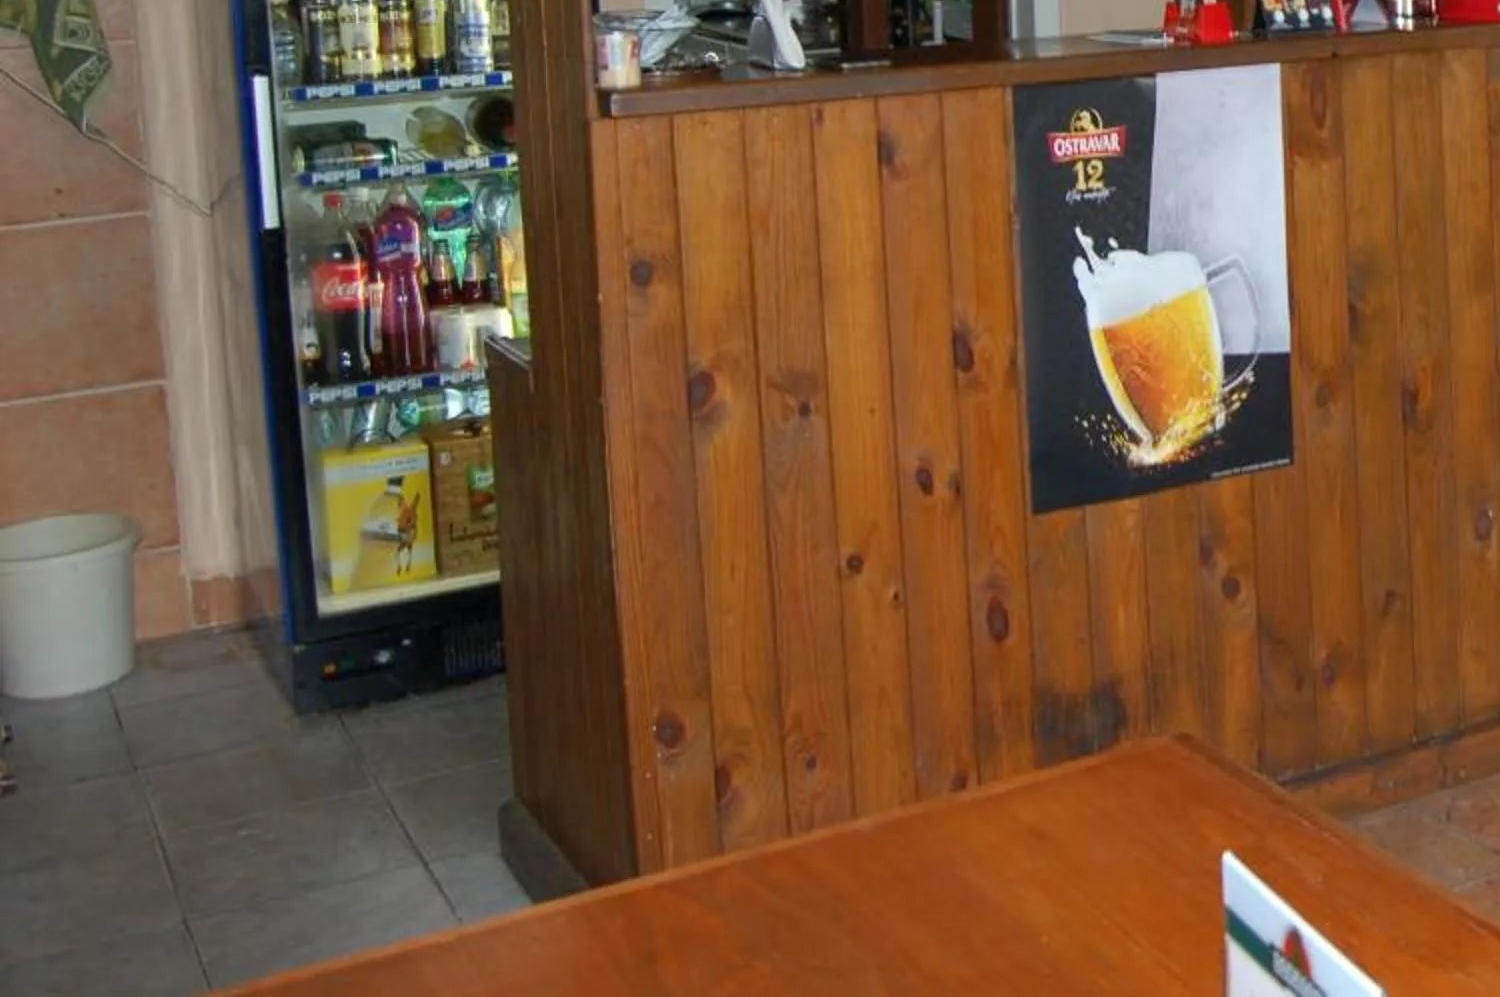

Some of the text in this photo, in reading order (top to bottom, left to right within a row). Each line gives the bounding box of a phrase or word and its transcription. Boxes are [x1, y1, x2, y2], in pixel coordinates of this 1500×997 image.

[1053, 132, 1120, 156] OSTRAVAR
[1072, 159, 1105, 191] 12
[309, 385, 357, 404] PEPSI
[376, 378, 422, 395] PEPSI
